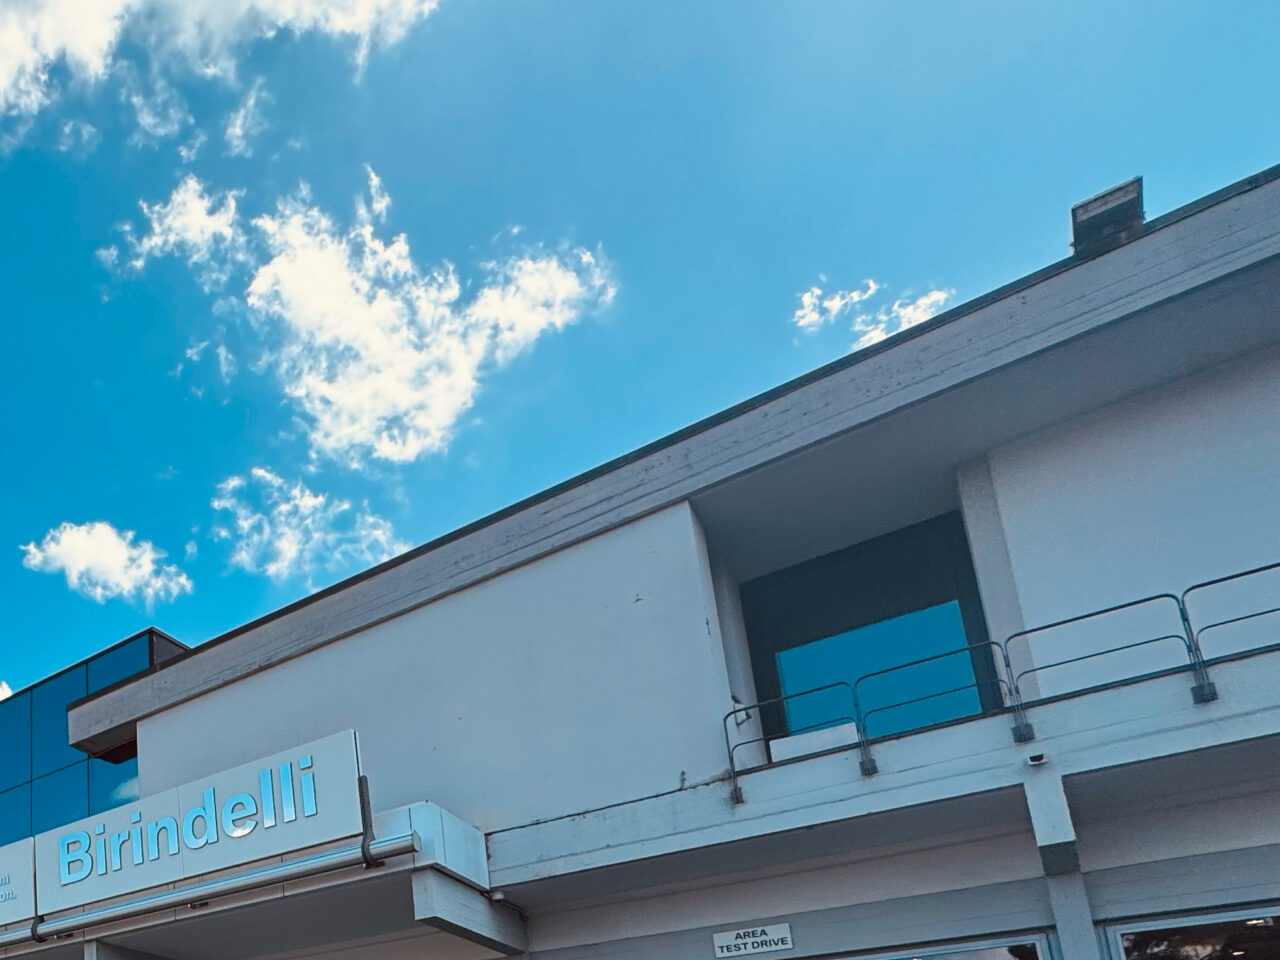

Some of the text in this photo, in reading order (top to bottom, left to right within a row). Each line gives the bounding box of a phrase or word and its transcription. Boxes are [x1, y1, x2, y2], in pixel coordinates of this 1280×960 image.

[59, 755, 317, 886] Birindelli
[735, 929, 768, 940] AREA
[718, 937, 789, 953] TEST DRIVE
